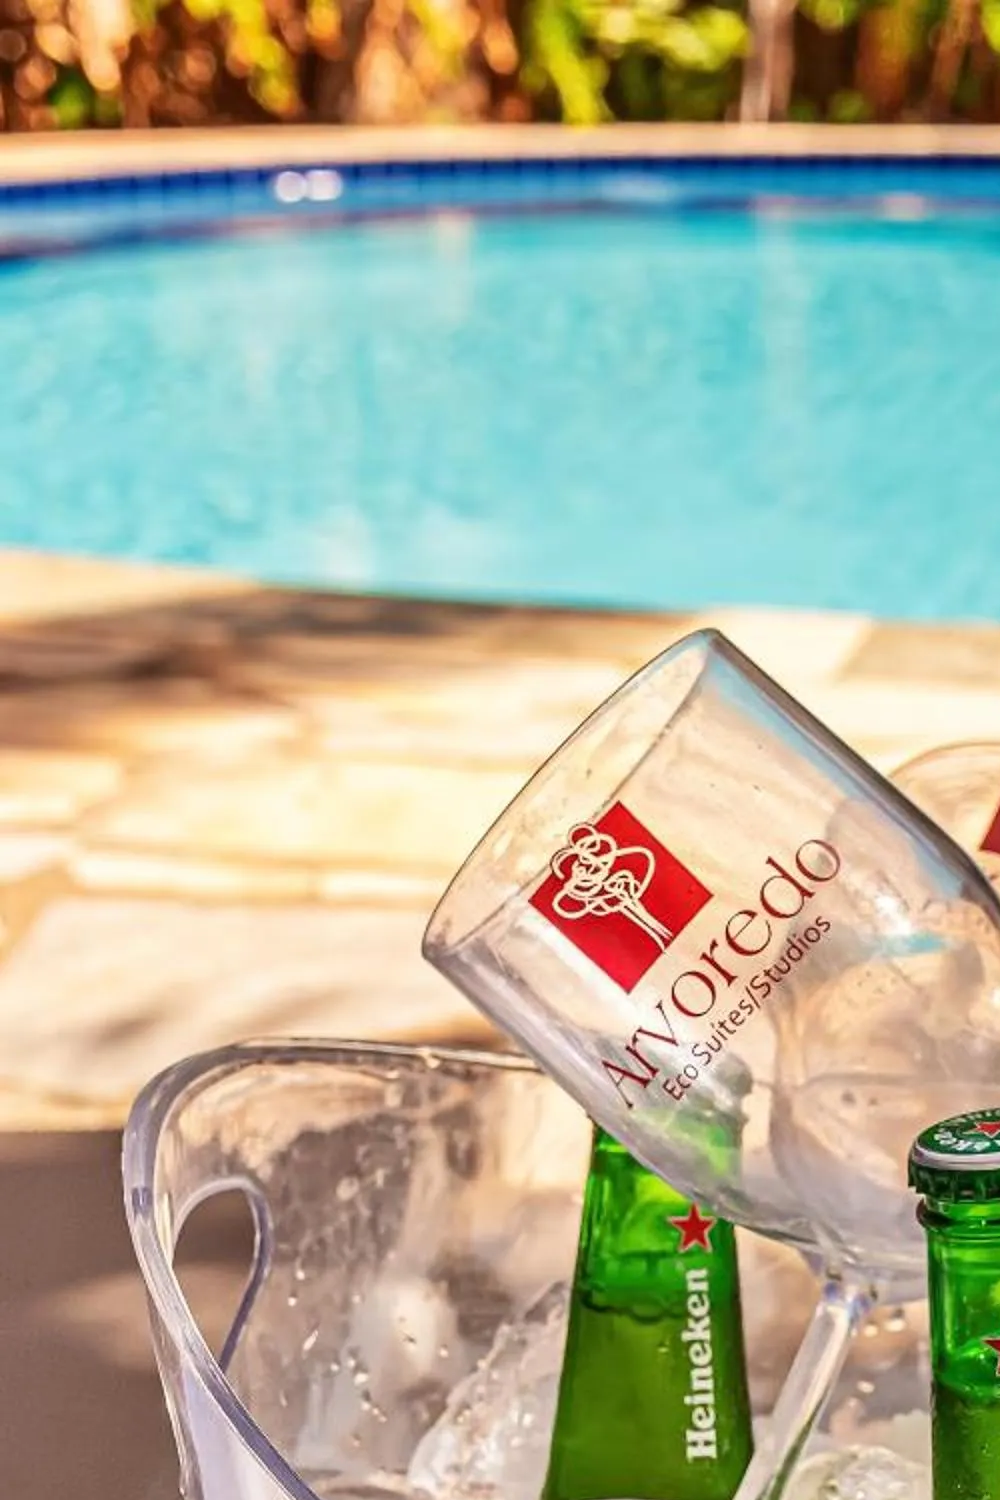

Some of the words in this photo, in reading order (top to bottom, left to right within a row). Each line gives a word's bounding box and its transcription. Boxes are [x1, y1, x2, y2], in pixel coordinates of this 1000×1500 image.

[601, 839, 841, 1109] Arvoredo
[662, 1063, 699, 1101] Eco
[681, 1268, 717, 1462] Heineken
